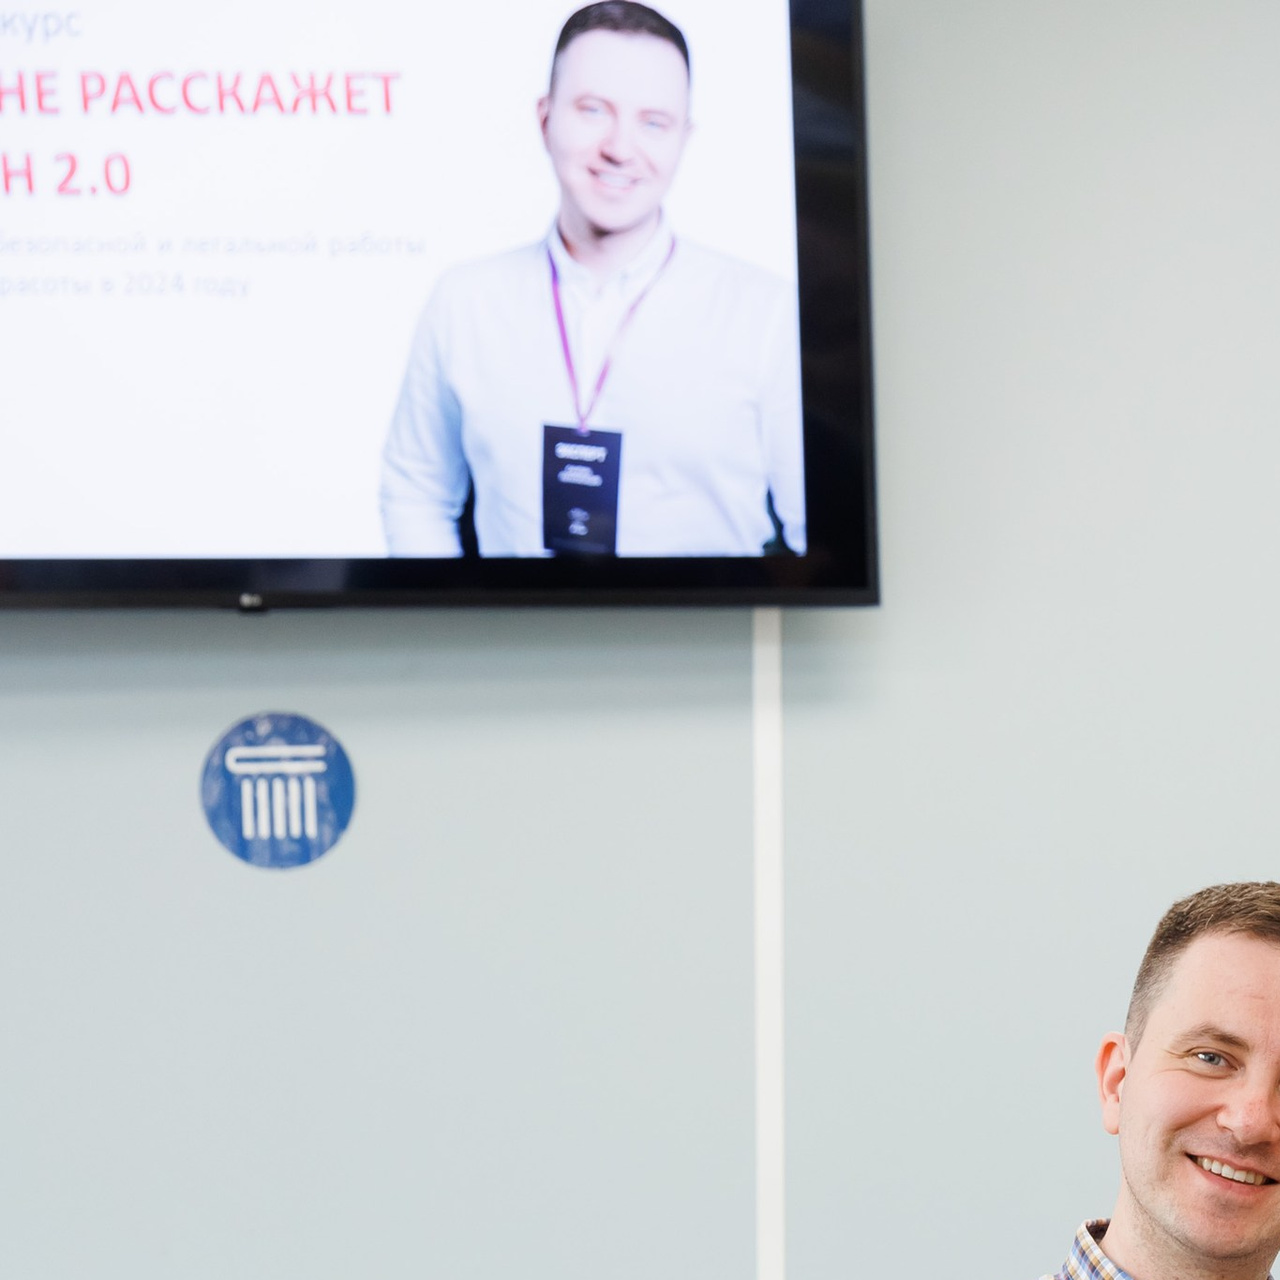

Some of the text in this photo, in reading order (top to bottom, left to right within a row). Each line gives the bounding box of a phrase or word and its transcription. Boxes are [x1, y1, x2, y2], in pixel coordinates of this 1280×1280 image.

[0, 11, 83, 43] курс
[0, 70, 401, 115] НЕ РАССКАЖЕТ
[54, 152, 132, 196] 2.0
